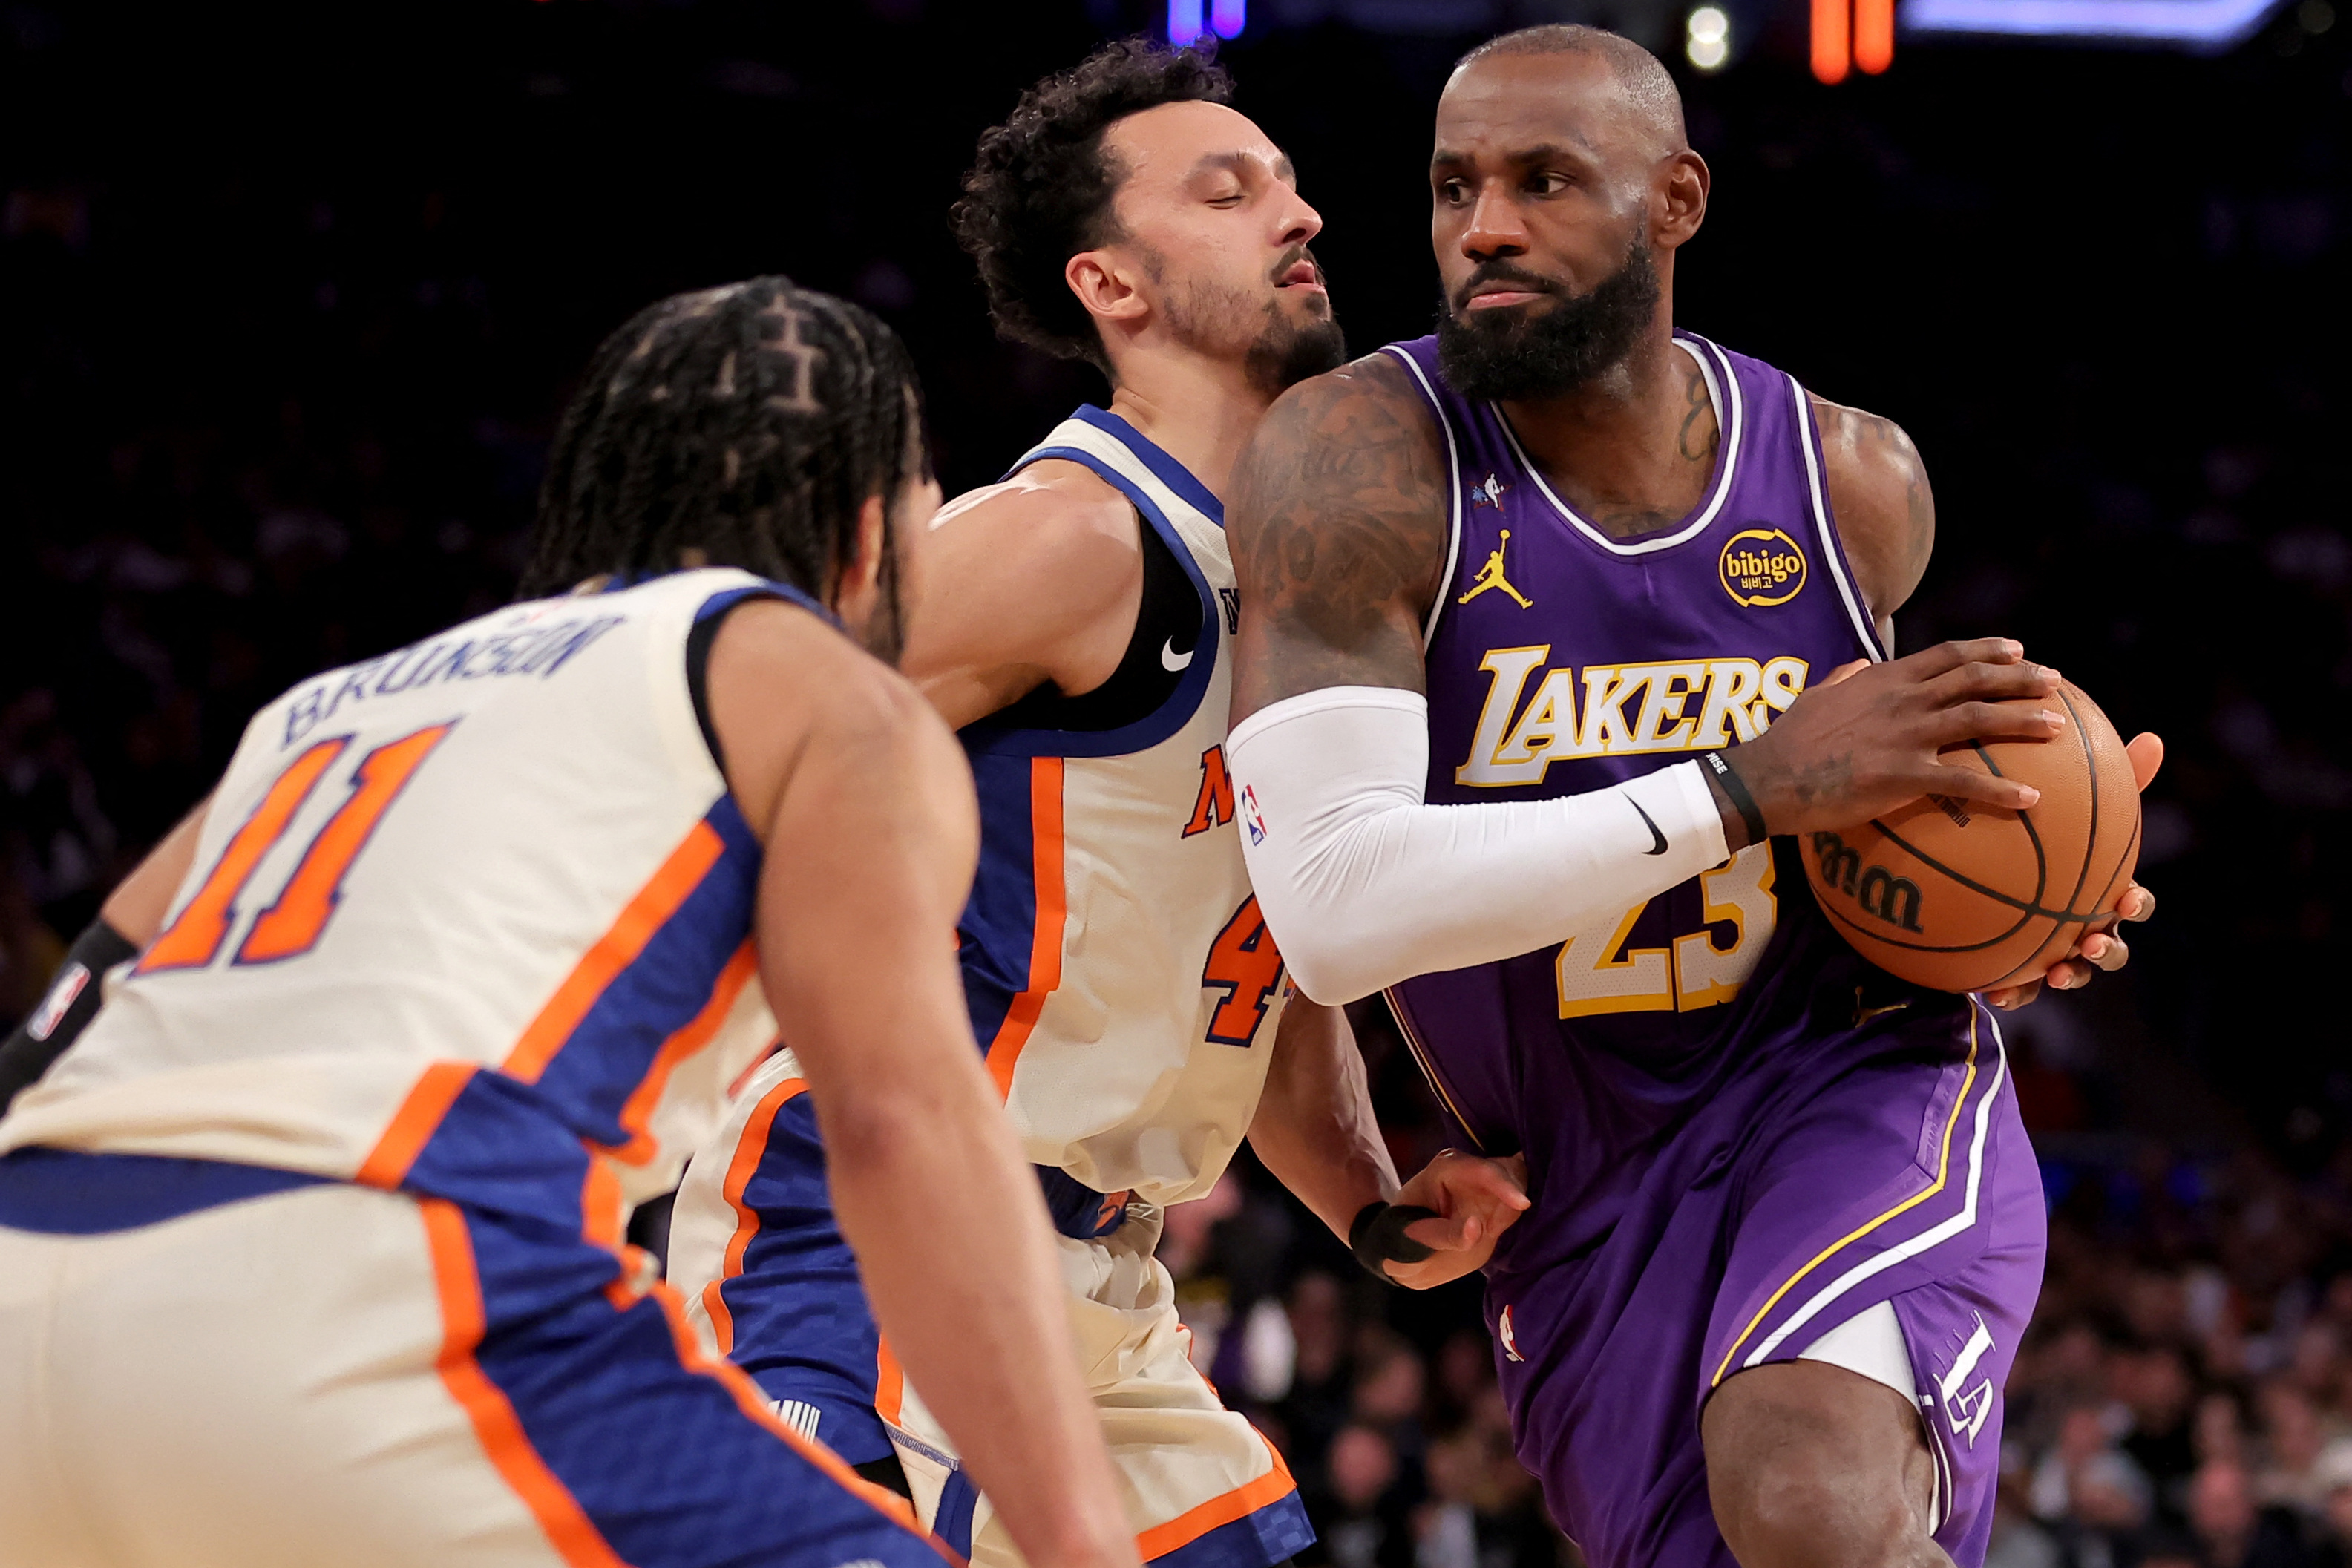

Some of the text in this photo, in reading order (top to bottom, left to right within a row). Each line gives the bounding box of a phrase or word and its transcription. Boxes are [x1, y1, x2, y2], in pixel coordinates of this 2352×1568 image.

[1726, 550, 1801, 583] bibigo
[1741, 577, 1773, 590] 비비고
[1455, 644, 1809, 787] LAKERS
[128, 717, 463, 980] 11
[1202, 891, 1299, 1048] 4
[1556, 837, 1778, 1019] 23
